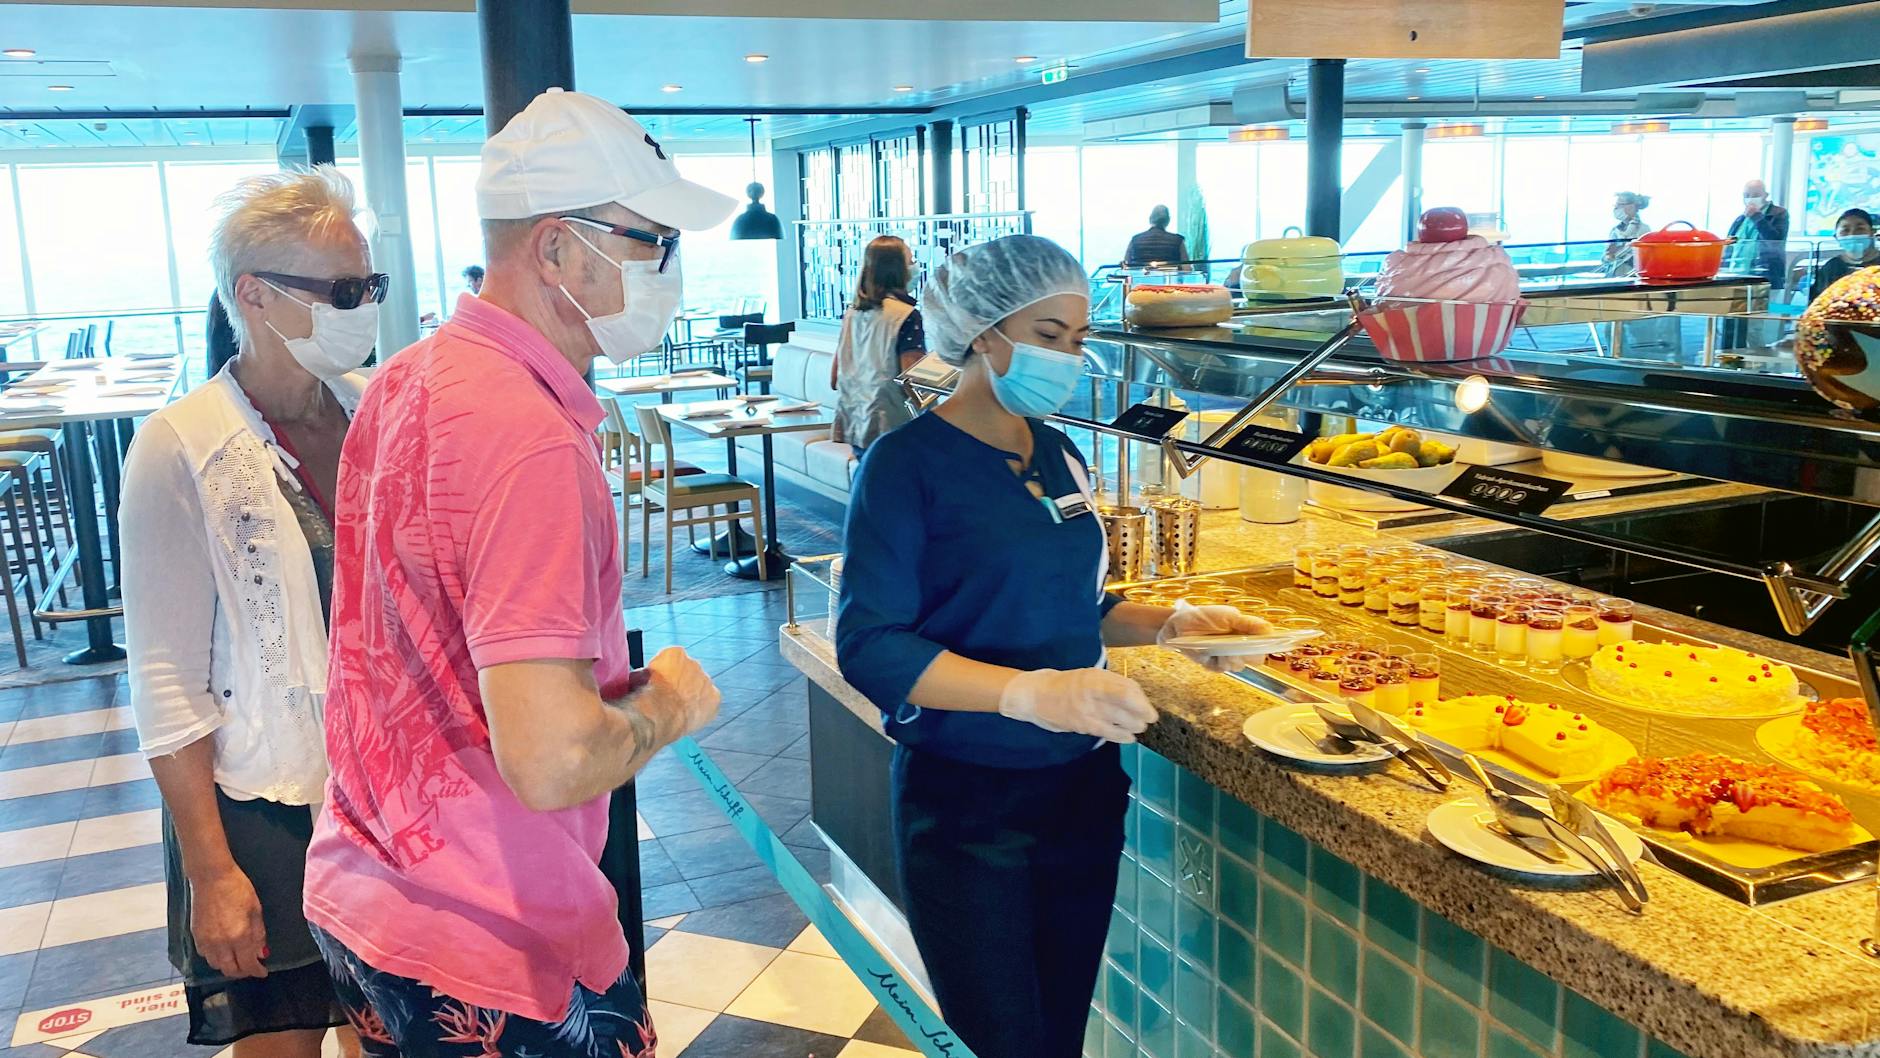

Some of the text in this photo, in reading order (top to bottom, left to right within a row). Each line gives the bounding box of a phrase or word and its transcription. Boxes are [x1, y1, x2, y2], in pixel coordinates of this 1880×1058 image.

[688, 753, 713, 785] Mein
[41, 1012, 89, 1030] STOP
[867, 968, 958, 1058] Mein Sch
